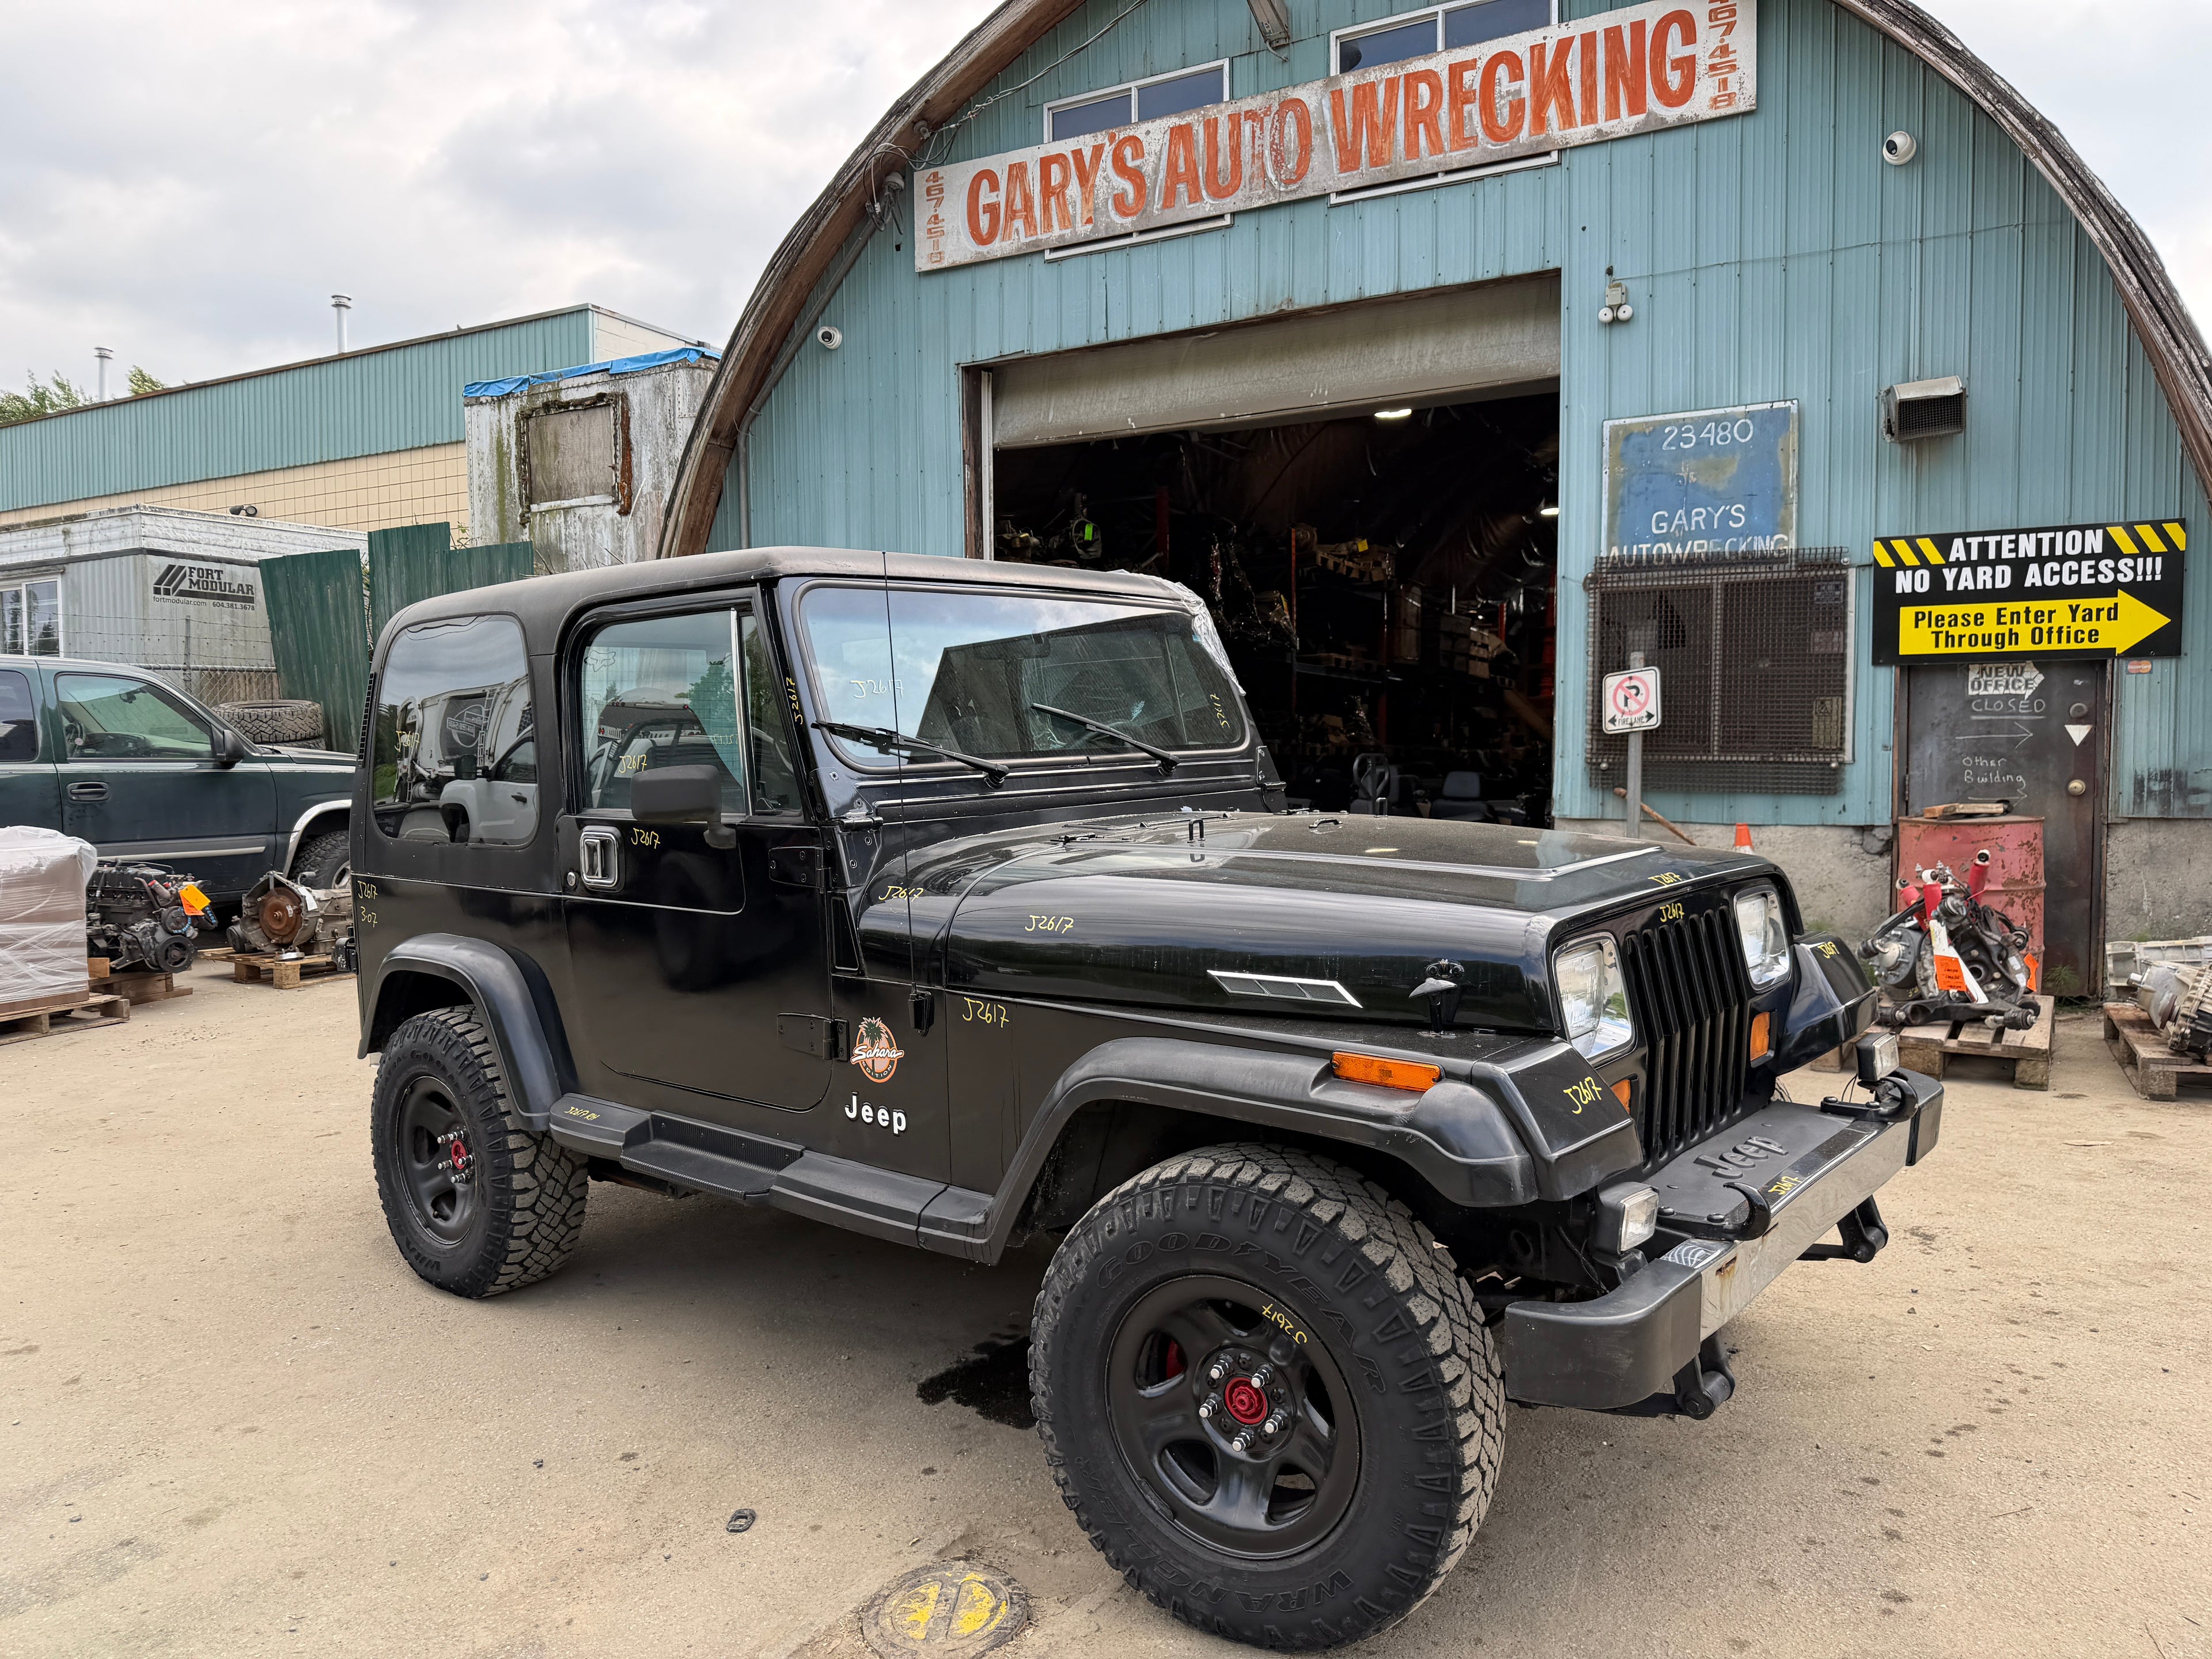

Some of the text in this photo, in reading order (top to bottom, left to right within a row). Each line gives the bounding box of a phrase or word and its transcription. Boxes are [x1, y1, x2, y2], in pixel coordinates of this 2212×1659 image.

[967, 10, 1698, 246] GARY'S AUTO WRECKING
[1662, 418, 1754, 450] 23480
[1651, 503, 1746, 535] GARY'S
[1948, 528, 2104, 562] ATTENTION
[187, 566, 224, 581] FORT
[1895, 556, 2162, 594] NO YARD ACCESS!!!
[188, 578, 255, 596] MODULAR
[153, 595, 255, 611] fortmodular.com 604.381.3678
[1914, 602, 2119, 629] Please Enter Yard
[1931, 626, 2100, 650] Through Office
[1978, 665, 2026, 678] NEW
[1969, 676, 2035, 692] OFFICE
[1971, 698, 2046, 713] CLOSED
[619, 754, 647, 774] J2617
[1961, 755, 2008, 767] Other
[1964, 770, 2027, 790] Building
[631, 827, 661, 849] J2617
[1024, 914, 1075, 934] J2617
[1659, 902, 1685, 923] J2617
[961, 997, 1010, 1028] J2617
[851, 1043, 904, 1063] Sahara
[861, 1060, 893, 1078] EDITION
[1563, 1075, 1603, 1115] J2617
[844, 1090, 908, 1137] Jeep
[1693, 1135, 1789, 1179] Jeep
[1097, 1232, 1387, 1395] GOODYEAR
[1261, 1302, 1308, 1345] J2617
[1074, 1455, 1356, 1615] WRANGLER
